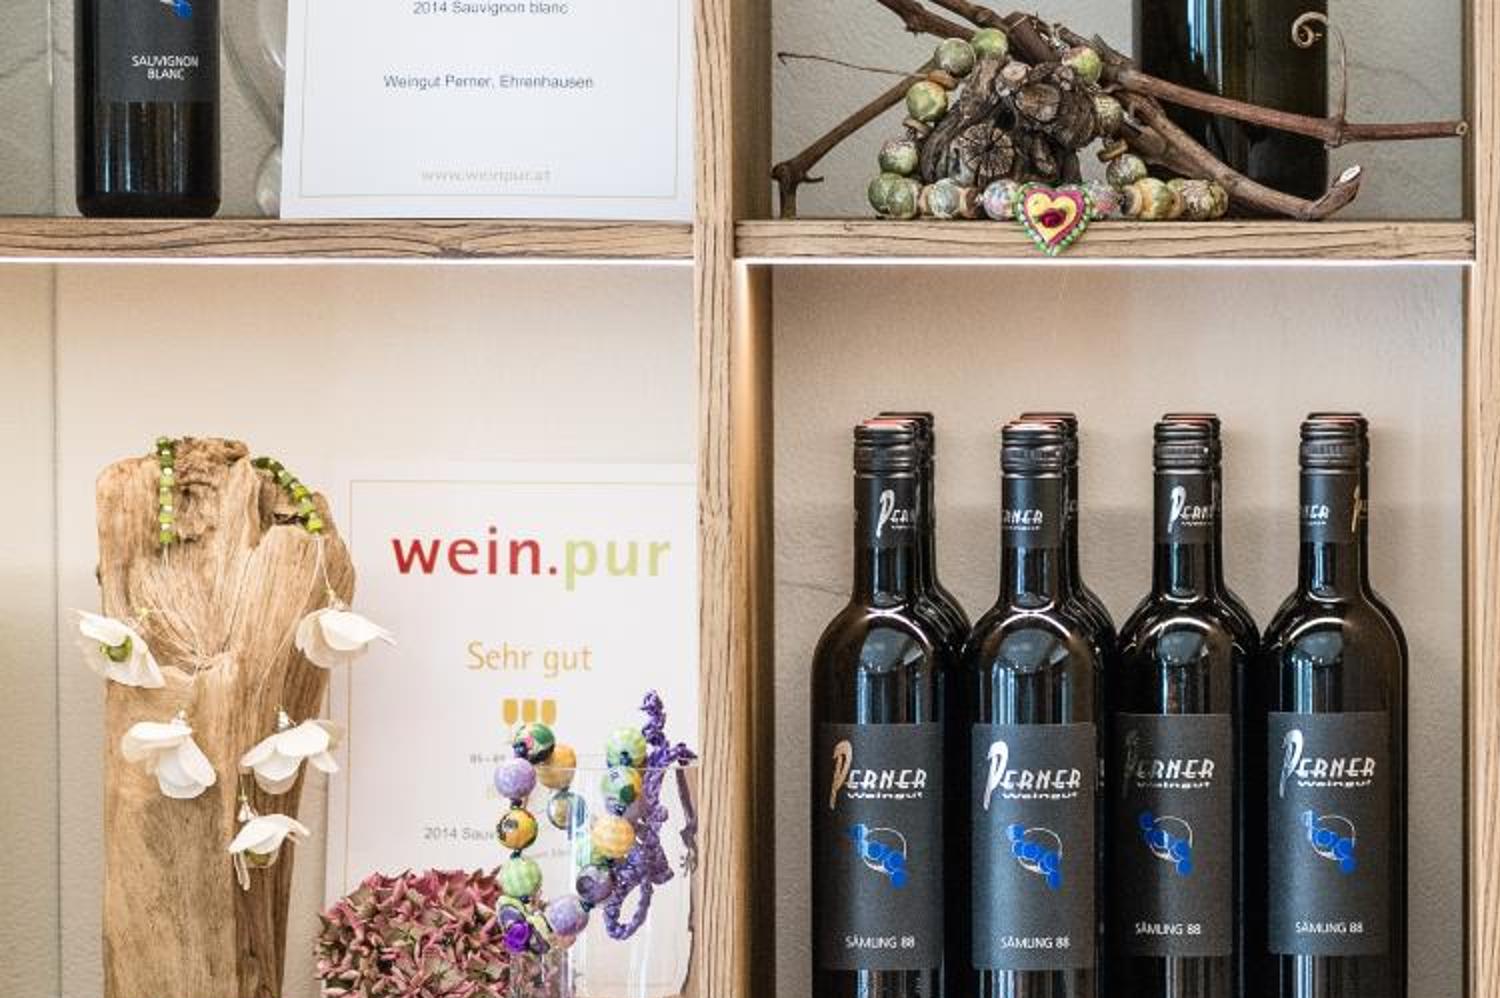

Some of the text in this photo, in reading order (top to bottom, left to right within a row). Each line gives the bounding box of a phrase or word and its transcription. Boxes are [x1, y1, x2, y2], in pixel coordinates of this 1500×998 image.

[452, 1, 525, 16] Sauvignon
[529, 1, 569, 15] blanc
[131, 55, 199, 68] SAUVIGNON
[146, 68, 185, 80] BLANC
[384, 75, 594, 91] Weingut Perner, Ehrenhausen
[392, 526, 671, 591] wein.pur
[467, 641, 592, 677] Sehr gut
[1280, 729, 1376, 798] PERNER
[830, 740, 927, 810] PERNER
[983, 740, 1081, 811] PERNER
[1135, 922, 1202, 935] SÄMLING 88
[1295, 921, 1363, 933] SÄMLING 88
[845, 935, 915, 949] SÄMLING 88
[1000, 935, 1053, 949] SÄMLING
